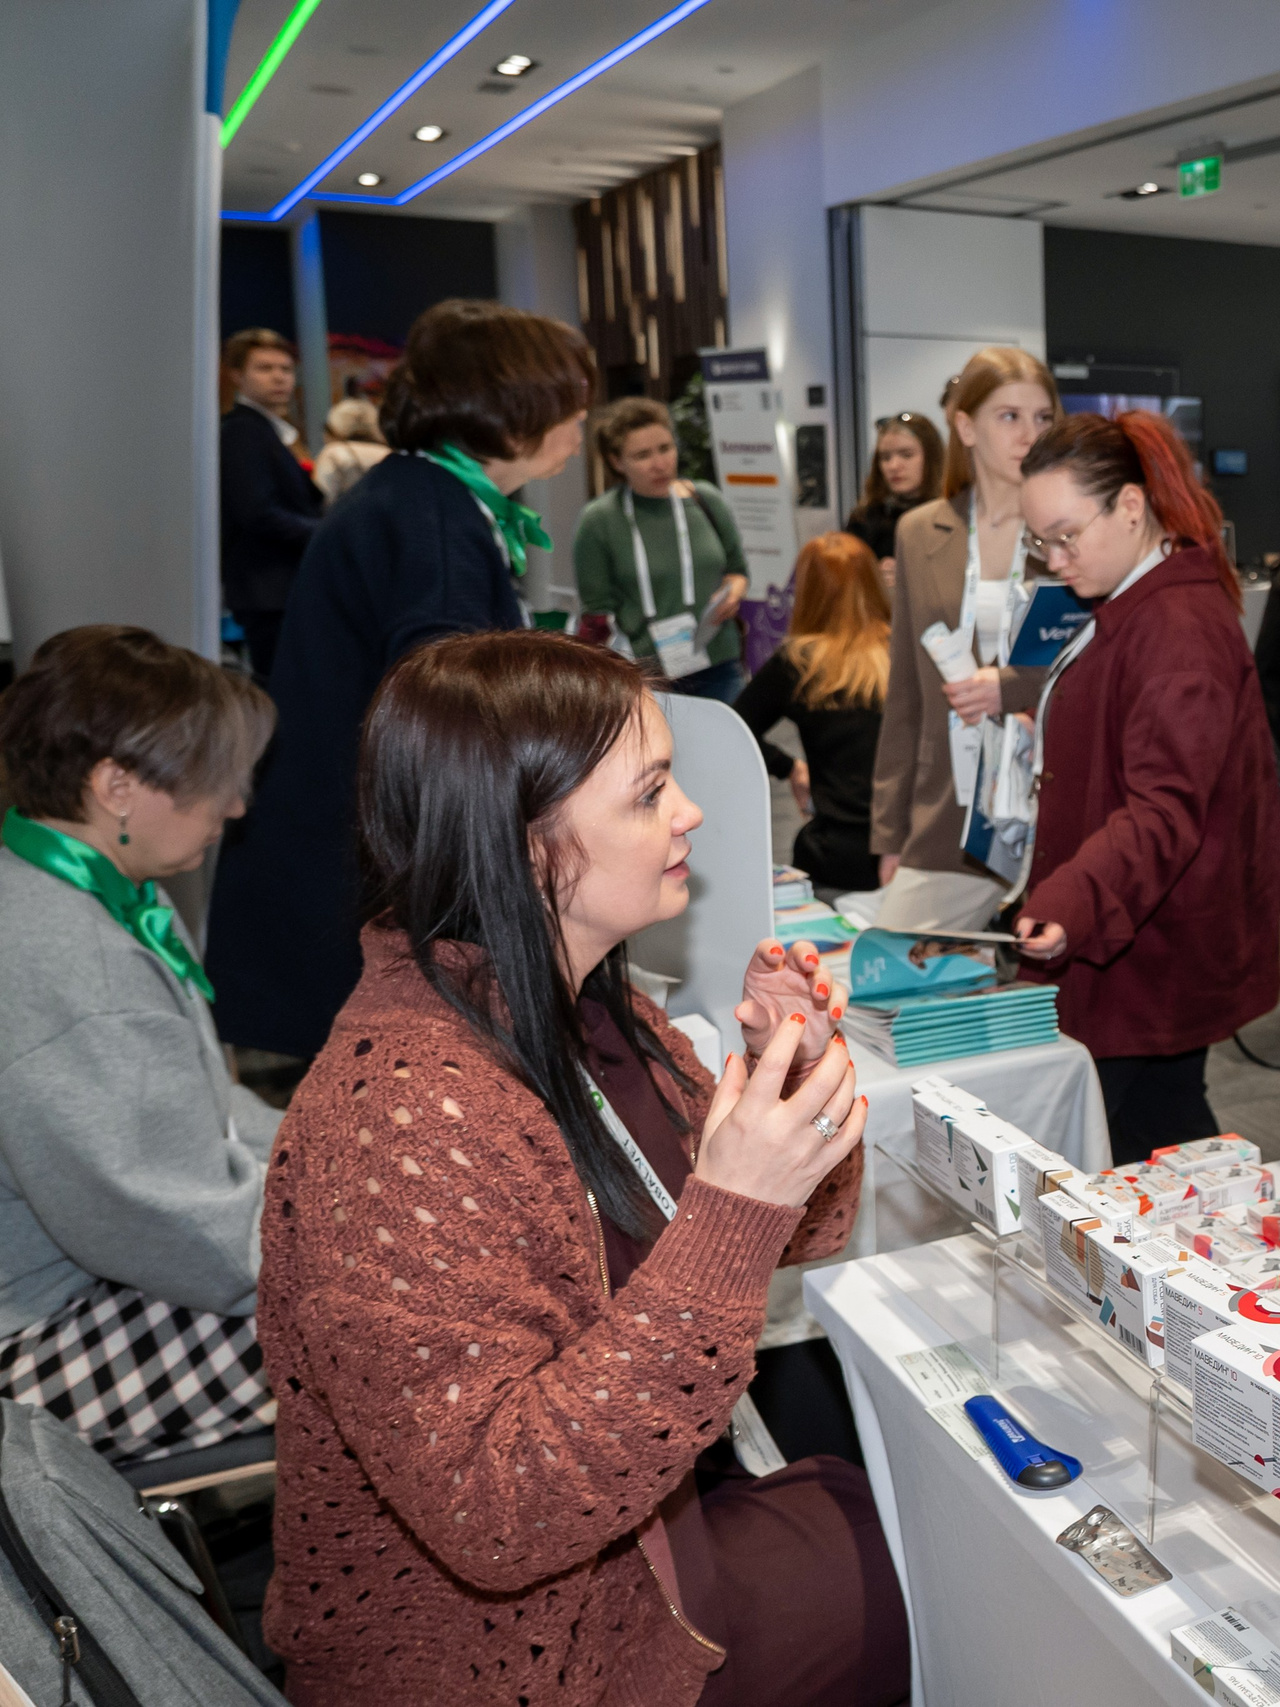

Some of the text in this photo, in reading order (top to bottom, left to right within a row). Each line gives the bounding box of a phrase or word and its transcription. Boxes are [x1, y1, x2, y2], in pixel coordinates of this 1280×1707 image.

[622, 1138, 676, 1218] LOBALVET
[1165, 1286, 1195, 1312] МАВЕДИН
[1194, 1348, 1238, 1382] МАВЕДИН 10
